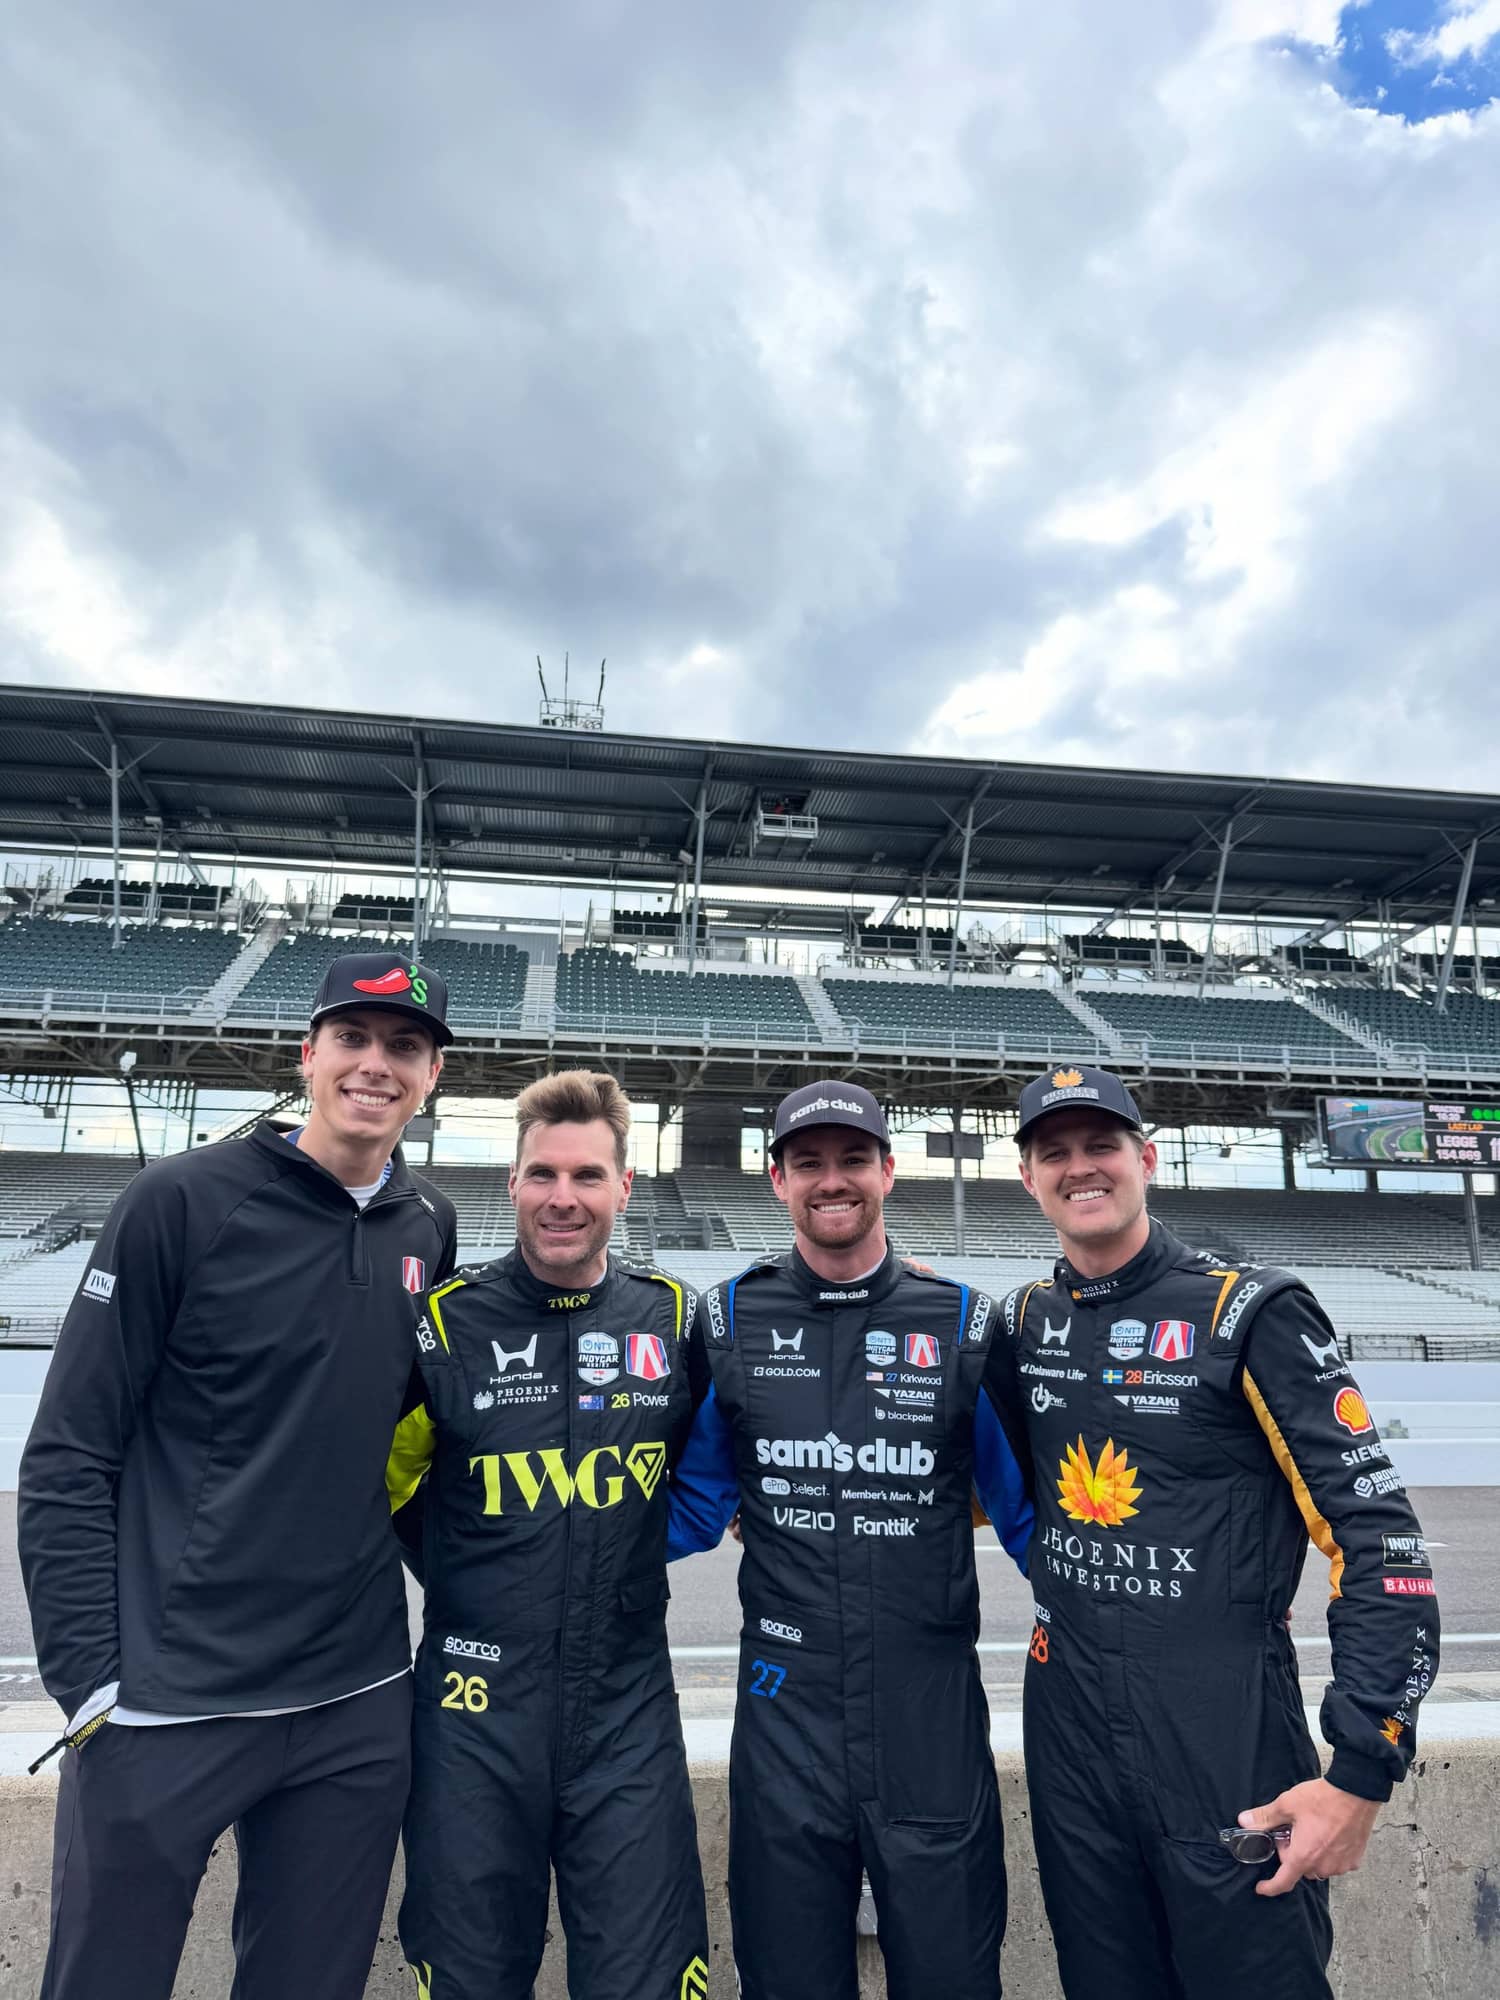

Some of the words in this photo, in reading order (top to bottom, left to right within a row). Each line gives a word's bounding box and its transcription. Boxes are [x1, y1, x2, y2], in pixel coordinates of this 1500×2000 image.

[789, 1098, 830, 1123] sam's
[830, 1098, 864, 1114] club
[1435, 1134, 1479, 1149] LEGGE
[819, 1290, 848, 1300] sam's
[847, 1288, 869, 1299] club
[547, 1295, 580, 1309] TWG
[707, 1287, 726, 1339] sparco
[968, 1294, 991, 1342] sparco
[1218, 1281, 1263, 1340] sparco
[593, 1342, 613, 1352] NTT
[865, 1344, 897, 1354] INDYCAR
[1036, 1347, 1071, 1358] Honda
[578, 1354, 619, 1364] INDYCAR
[767, 1353, 806, 1361] Honda
[489, 1371, 543, 1385] Honda
[765, 1367, 821, 1378] GOLD.COM
[885, 1371, 899, 1382] 27
[900, 1373, 942, 1386] Kirkwood
[1028, 1363, 1066, 1379] Delaware
[1066, 1368, 1083, 1381] Life
[1124, 1369, 1143, 1384] 28
[1143, 1370, 1199, 1387] Ericsson
[496, 1384, 560, 1398] PHOENIX
[892, 1389, 936, 1401] YAZAKI
[496, 1395, 548, 1406] INVESTORS
[611, 1393, 631, 1409] 26
[632, 1392, 670, 1408] Power
[1131, 1395, 1180, 1407] YAZAKI
[887, 1411, 934, 1424] blackpoint
[755, 1431, 855, 1472] sam's
[856, 1438, 938, 1477] club
[468, 1445, 627, 1516] TWG
[841, 1489, 888, 1501] Member's
[889, 1491, 913, 1502] Mark
[773, 1506, 836, 1532] VIZIO
[853, 1515, 917, 1537] Fanttik
[1387, 1537, 1416, 1551] INDY
[1045, 1554, 1184, 1598] INVESTORS
[759, 1617, 802, 1643] sparco
[442, 1635, 501, 1662] sparco
[749, 1659, 787, 1700] 27
[441, 1670, 489, 1713] 26
